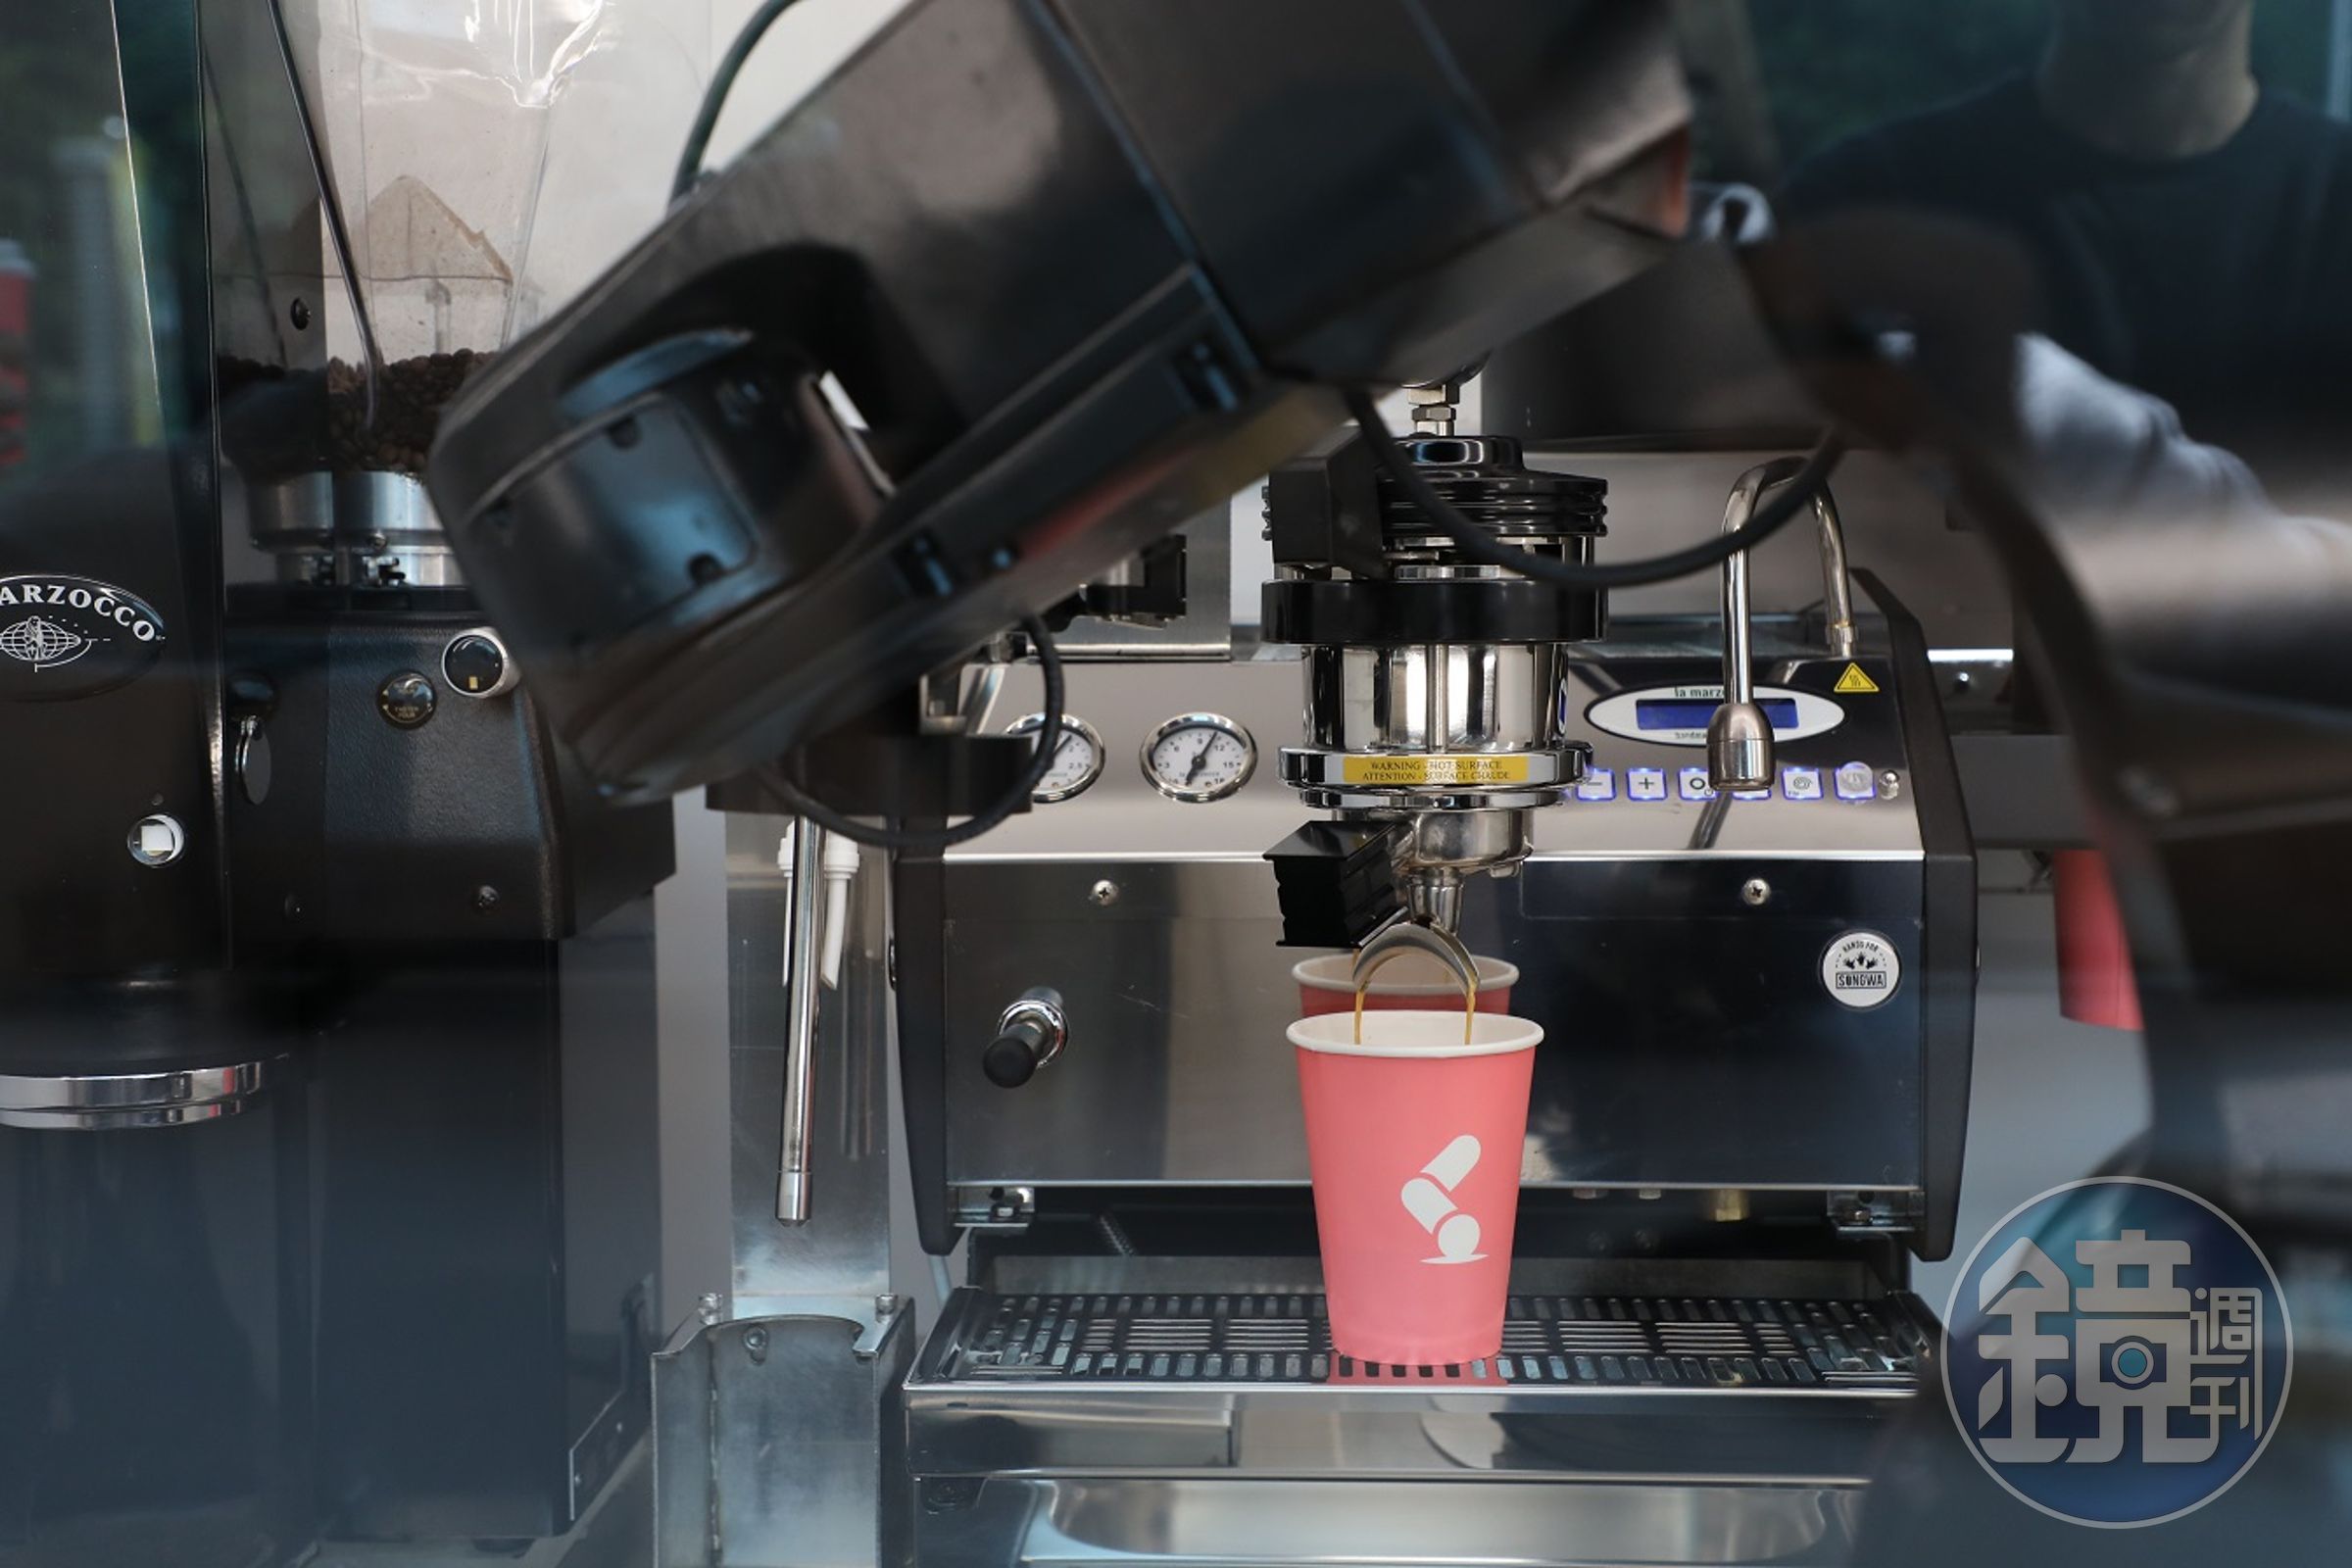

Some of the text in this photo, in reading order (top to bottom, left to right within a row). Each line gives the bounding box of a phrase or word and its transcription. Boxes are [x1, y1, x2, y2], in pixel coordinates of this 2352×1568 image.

[1371, 760, 1420, 770] WARNING
[1430, 760, 1452, 770] HOT
[1455, 760, 1502, 770] SURFACE
[1362, 771, 1416, 781] ATTENTION
[1424, 771, 1467, 781] SURFACE
